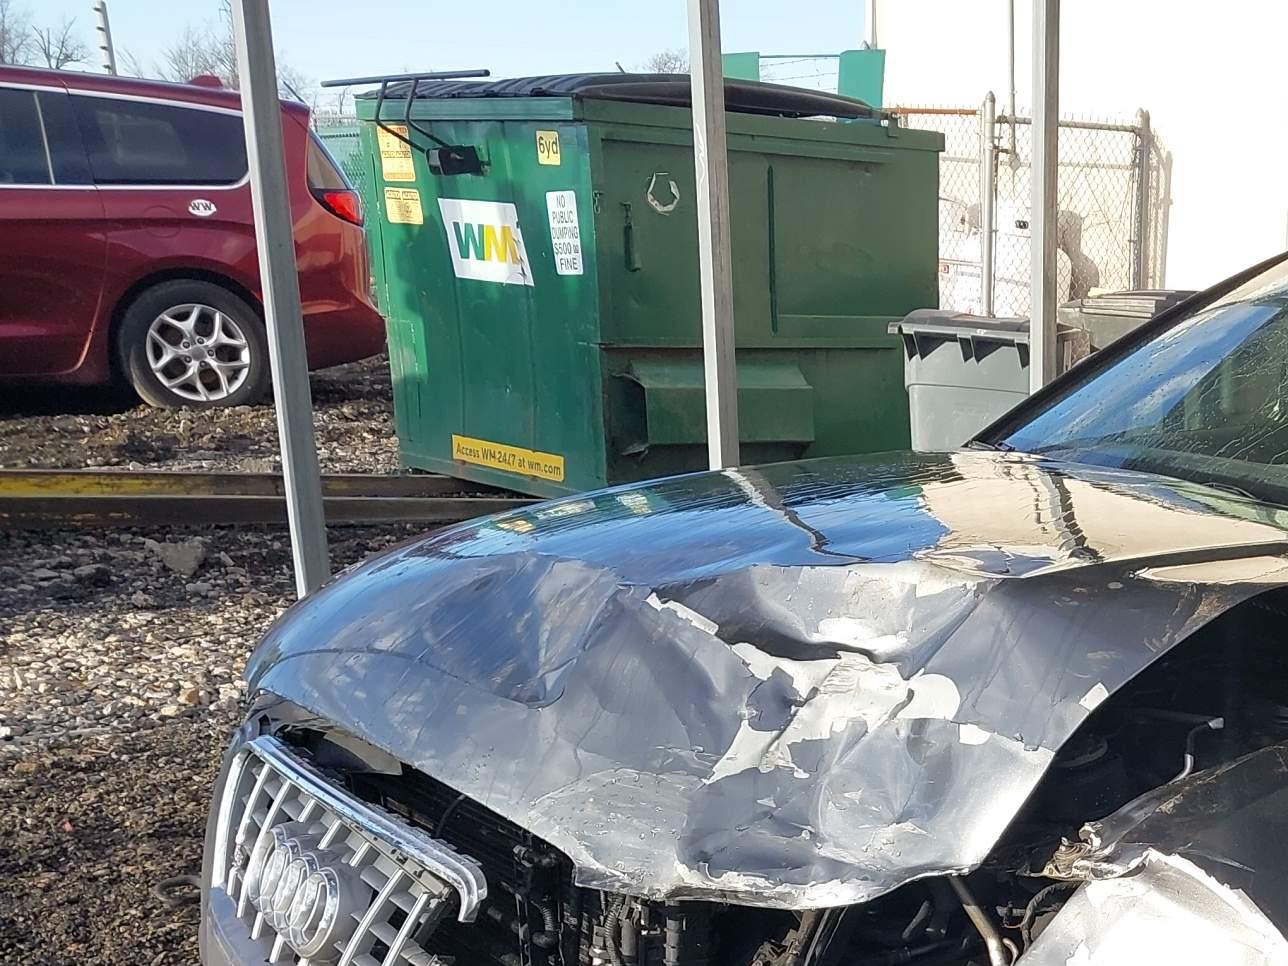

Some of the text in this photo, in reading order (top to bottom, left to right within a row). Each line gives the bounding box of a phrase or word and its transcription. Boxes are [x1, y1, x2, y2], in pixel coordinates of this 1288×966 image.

[538, 136, 559, 158] 6yd
[556, 195, 566, 208] NO
[552, 211, 574, 224] PUBLIC
[552, 227, 579, 240] DUMPING
[453, 221, 520, 265] WM
[559, 258, 578, 271] FINE
[456, 442, 480, 459] Access
[497, 451, 516, 466] 24/7
[518, 457, 526, 469] at
[527, 461, 561, 476] wm.com
